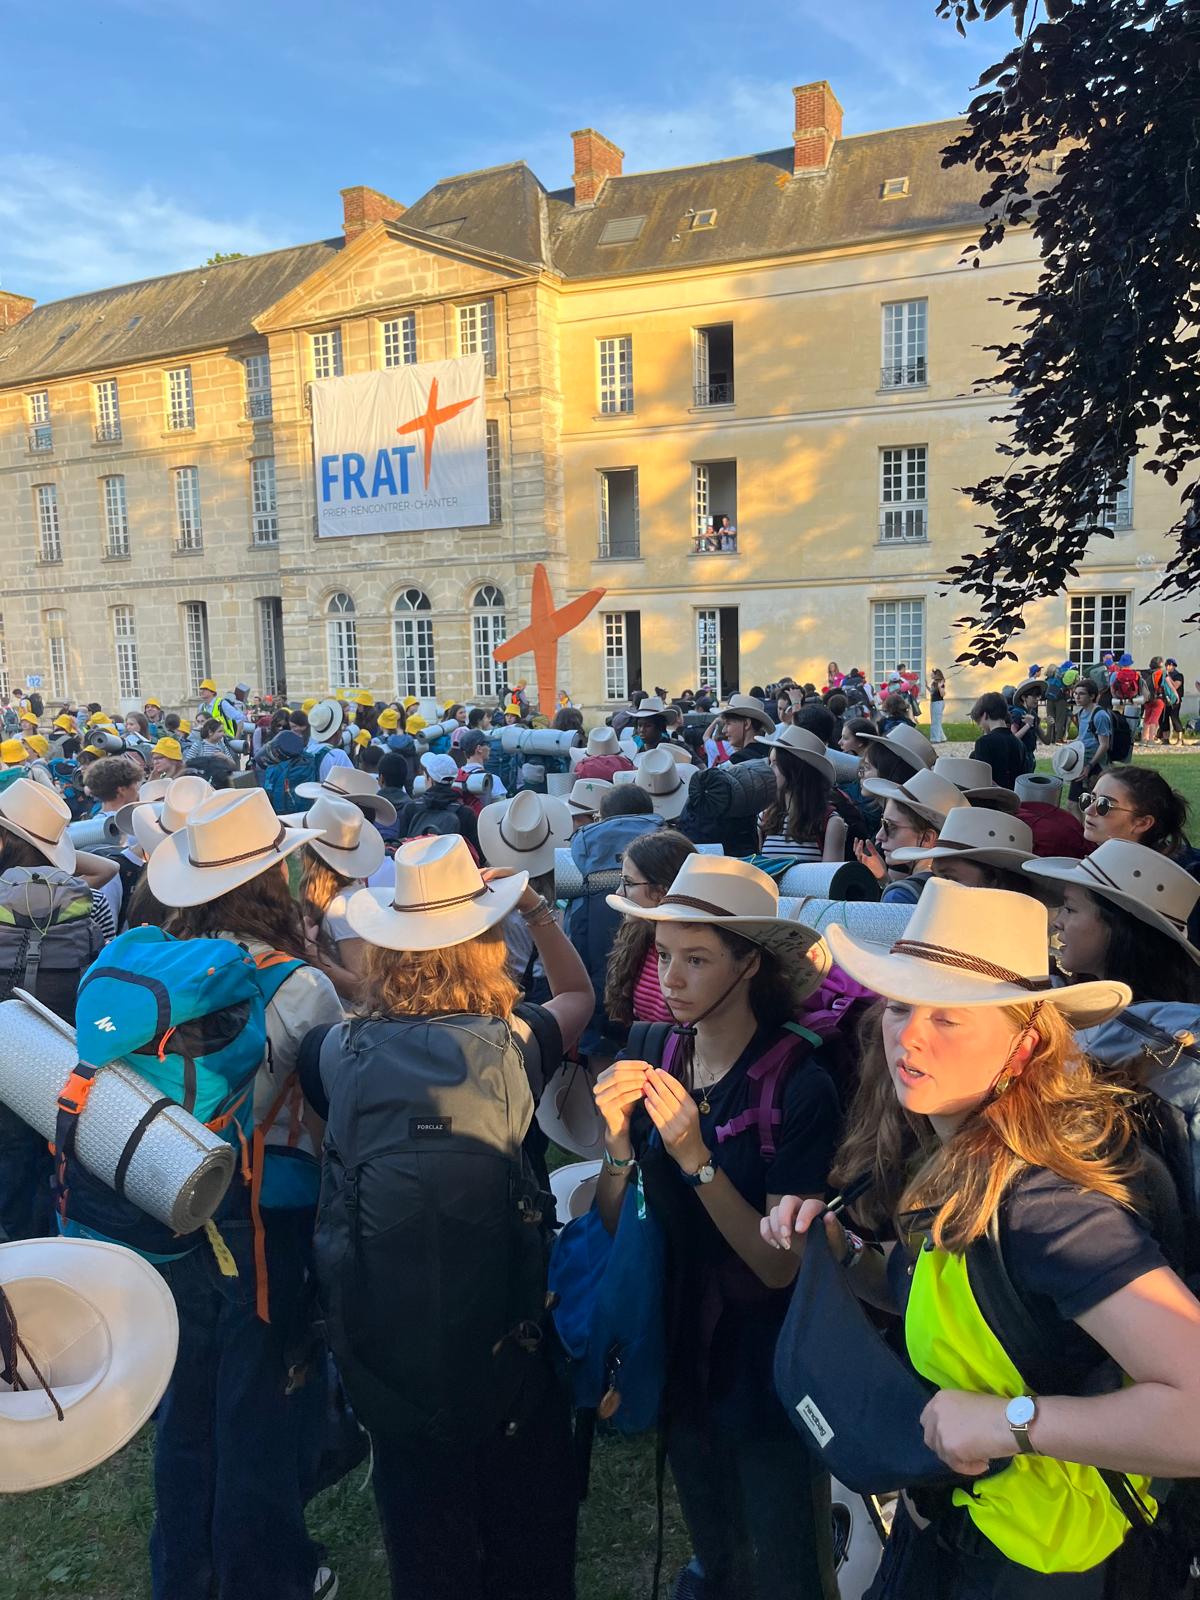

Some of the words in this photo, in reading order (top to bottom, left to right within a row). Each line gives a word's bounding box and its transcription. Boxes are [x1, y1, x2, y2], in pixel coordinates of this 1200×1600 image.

[321, 445, 416, 502] FRAT
[322, 507, 347, 518] PRIER
[351, 501, 410, 516] RENCONTRER
[414, 496, 458, 510] CHANTER
